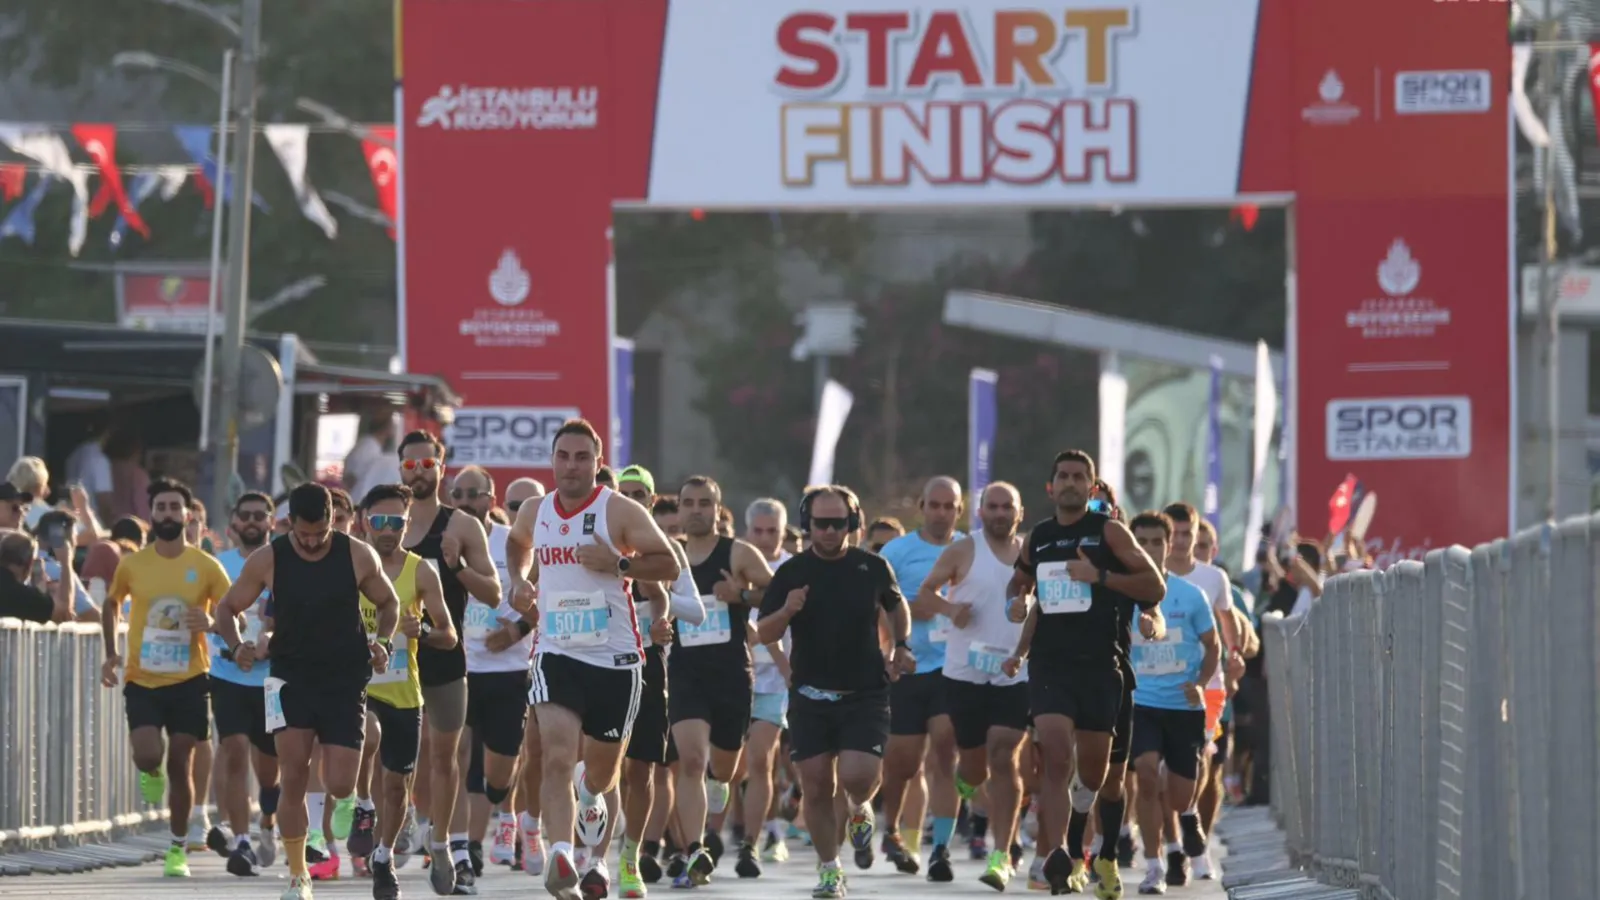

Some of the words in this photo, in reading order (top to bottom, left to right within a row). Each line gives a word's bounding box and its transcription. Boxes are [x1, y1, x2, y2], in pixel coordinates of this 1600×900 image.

[774, 8, 1132, 91] START
[780, 99, 1138, 186] FINISH
[1336, 404, 1458, 432] SPOR
[1044, 580, 1082, 600] 5875
[555, 610, 596, 635] 5071
